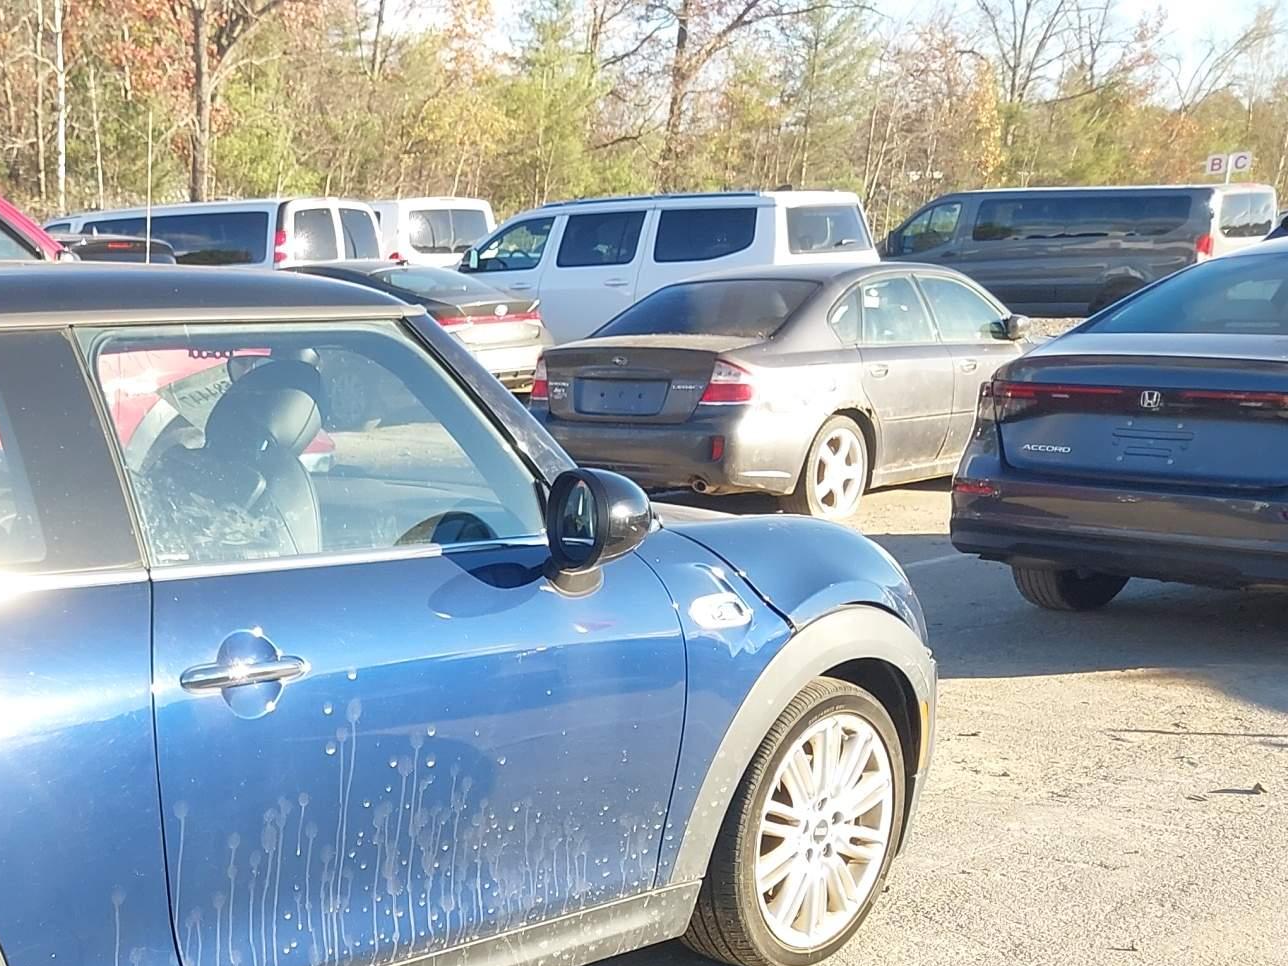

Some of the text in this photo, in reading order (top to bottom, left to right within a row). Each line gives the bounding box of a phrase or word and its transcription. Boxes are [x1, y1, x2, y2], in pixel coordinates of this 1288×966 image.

[1210, 158, 1224, 172] B
[1234, 155, 1248, 170] C
[1022, 443, 1073, 454] ACCORD
